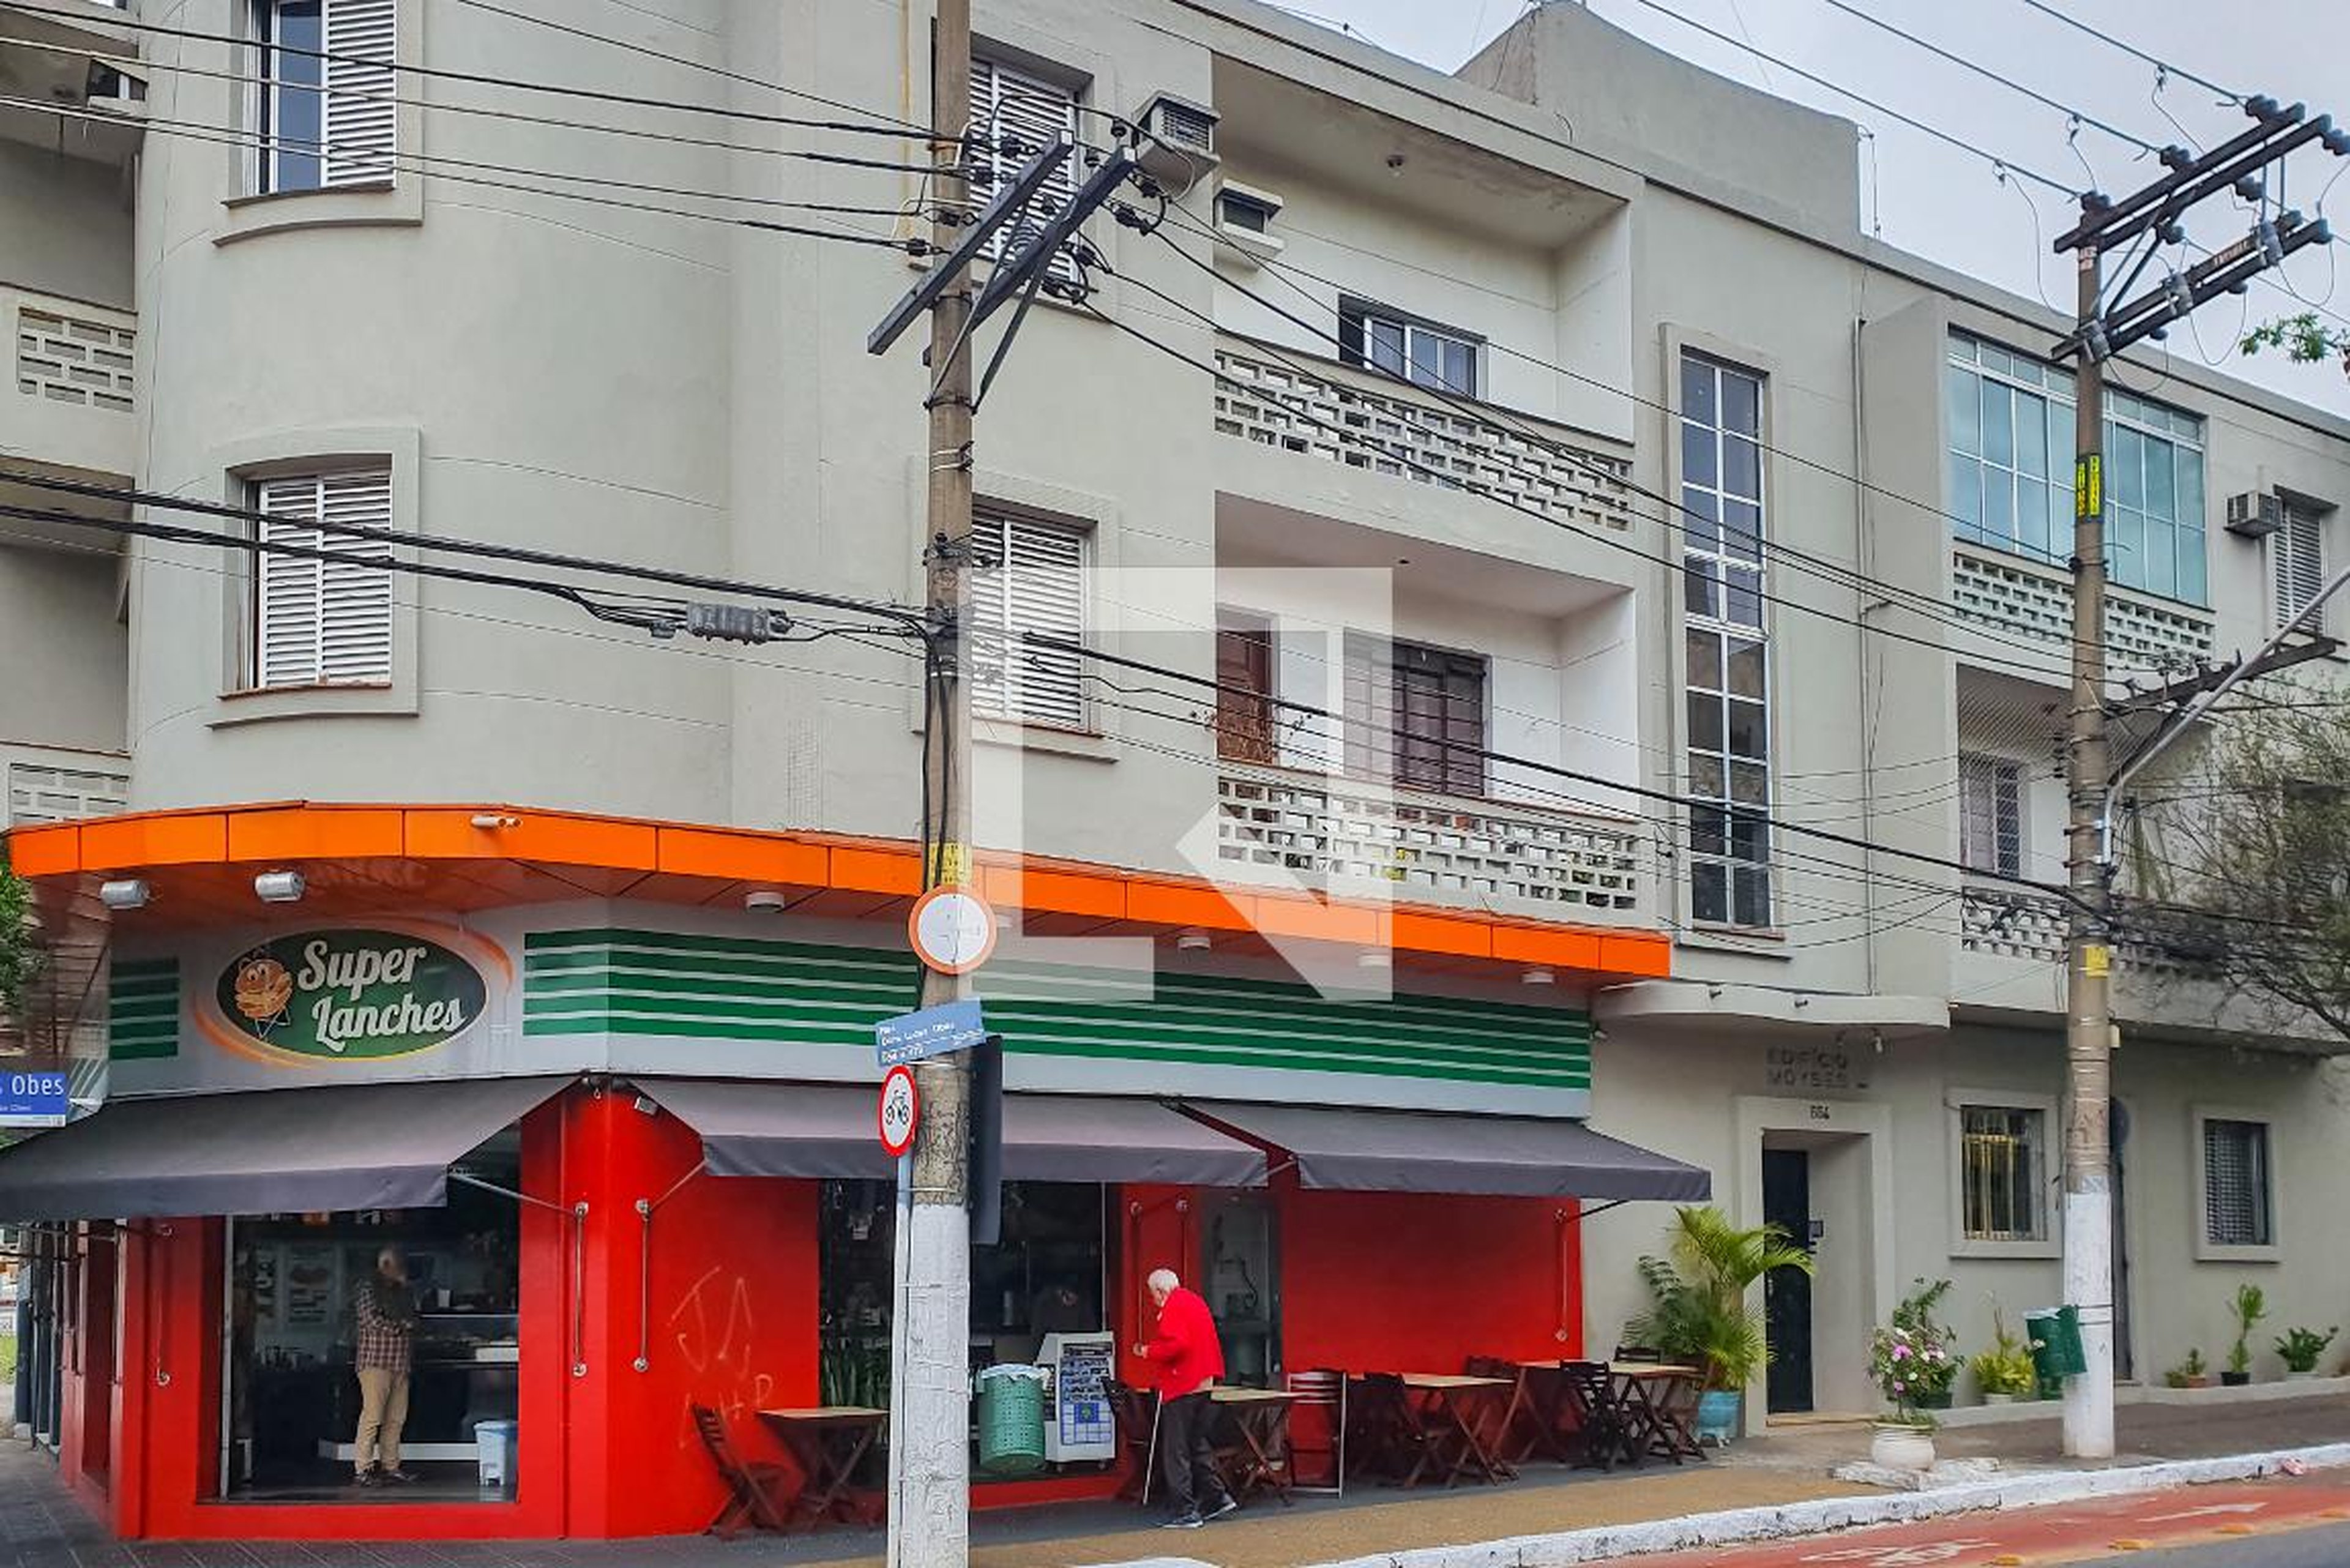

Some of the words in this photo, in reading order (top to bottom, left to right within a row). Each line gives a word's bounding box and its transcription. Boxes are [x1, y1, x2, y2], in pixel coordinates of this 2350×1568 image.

[297, 940, 427, 1001] Super
[311, 992, 467, 1053] Lanches
[12, 1073, 64, 1096] Obes
